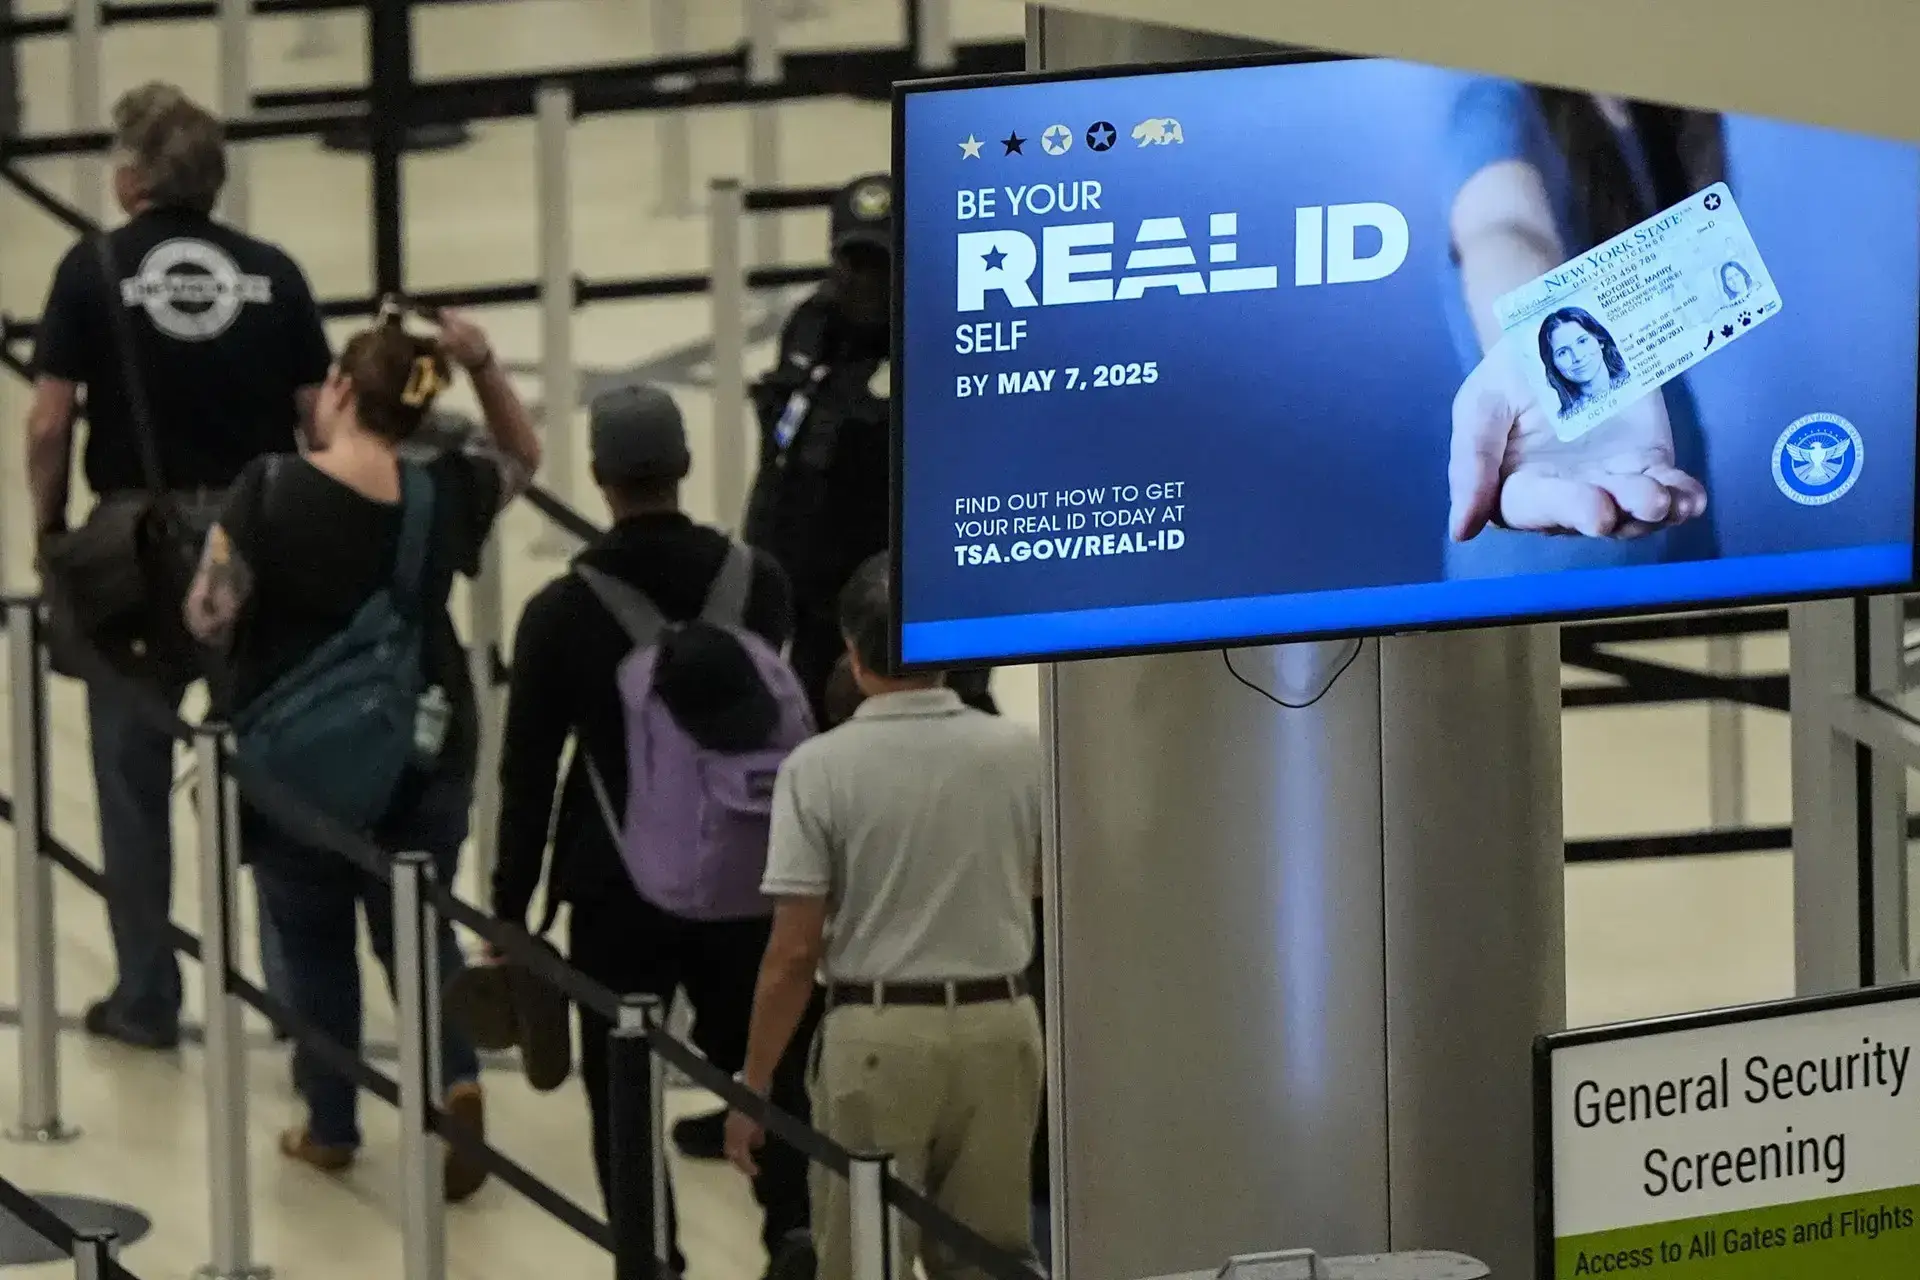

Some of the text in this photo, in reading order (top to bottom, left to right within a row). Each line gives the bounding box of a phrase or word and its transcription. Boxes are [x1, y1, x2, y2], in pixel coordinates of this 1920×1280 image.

[956, 180, 1103, 220] BE YOUR
[956, 202, 1410, 313] REAL ID
[1543, 213, 1683, 293] NEW YORK STATE
[1572, 235, 1667, 289] DRIVER LICENSE
[1600, 252, 1658, 288] 123 456 789
[1597, 274, 1640, 302] MOTORIST
[1600, 263, 1674, 310] MICHELLE, MARRY
[955, 320, 1028, 355] SELF
[956, 362, 1159, 398] BY MAY 7, 2025
[955, 481, 1185, 515] FIND OUT HOW TO GET
[954, 505, 1185, 538] YOUR REAL ID TODAY AT
[954, 528, 1186, 566] TSA.GOV/REAL-ID
[1573, 1037, 1911, 1128] General Security
[1643, 1126, 1846, 1197] Screening
[1574, 1204, 1914, 1276] Access to All Gates and Flights
